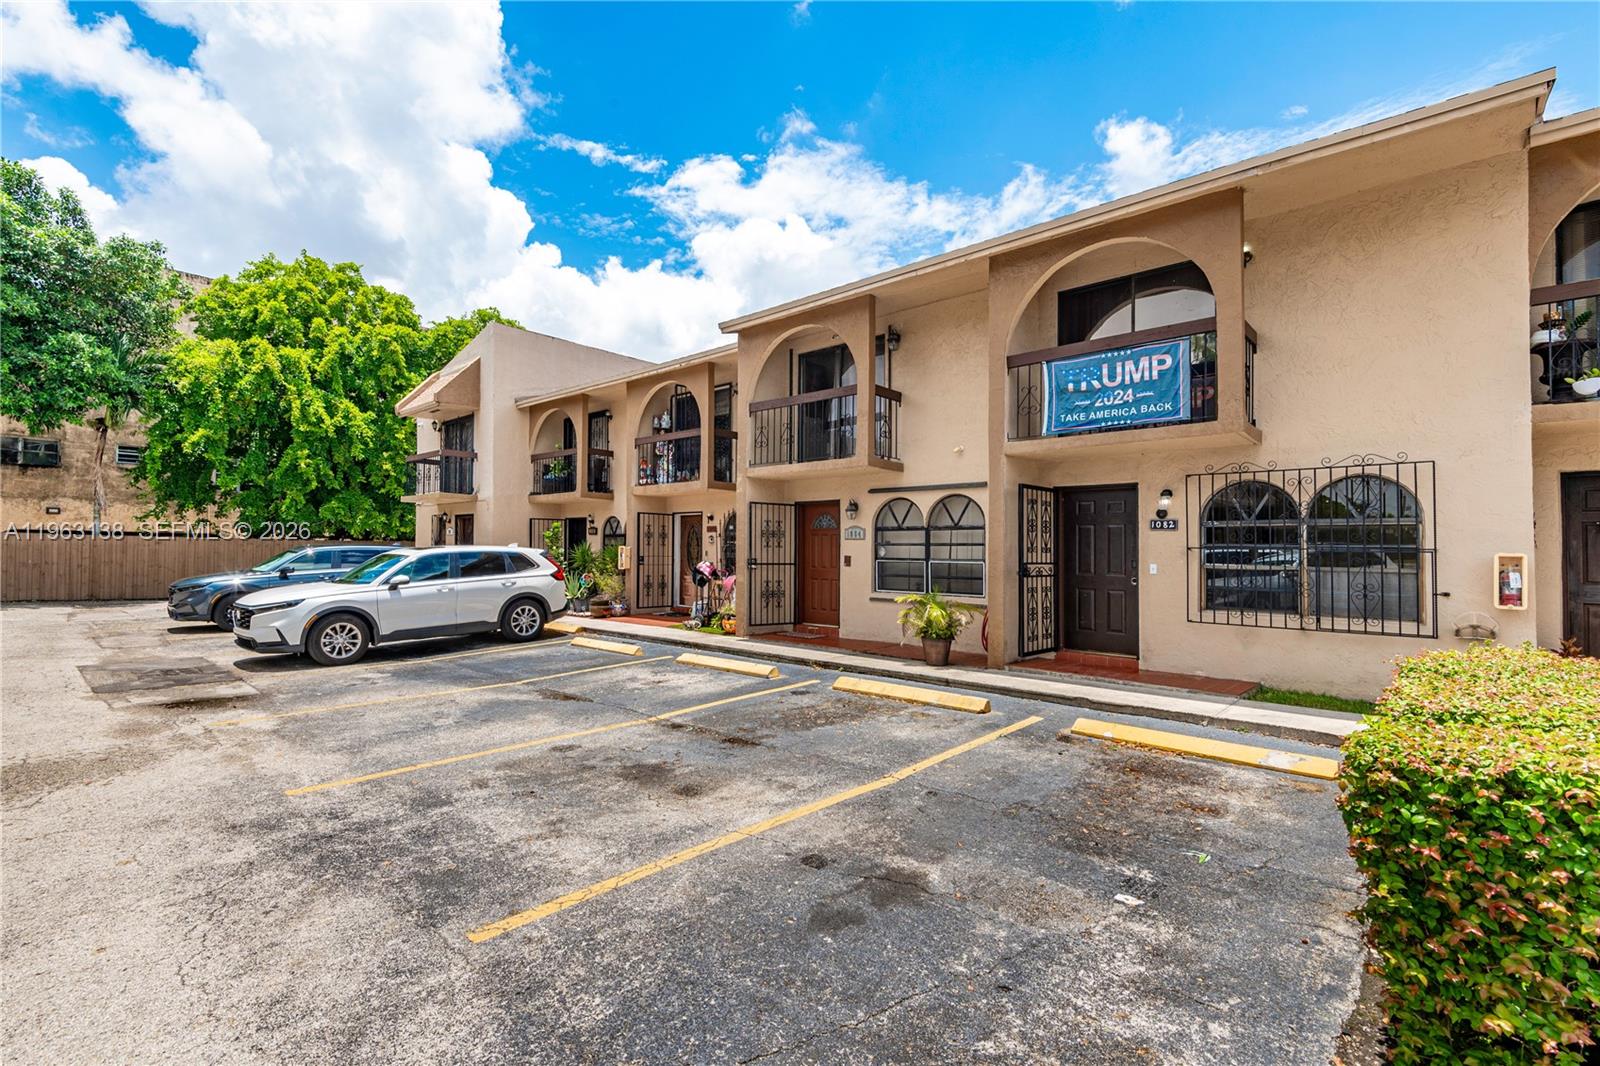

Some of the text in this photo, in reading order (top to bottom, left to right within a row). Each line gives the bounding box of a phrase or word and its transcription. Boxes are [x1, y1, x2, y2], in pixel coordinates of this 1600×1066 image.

[1061, 353, 1173, 393] TRUMP
[1094, 388, 1135, 407] 2024
[1060, 402, 1173, 423] TAKE AMERICA BACK
[1152, 520, 1175, 528] 1082
